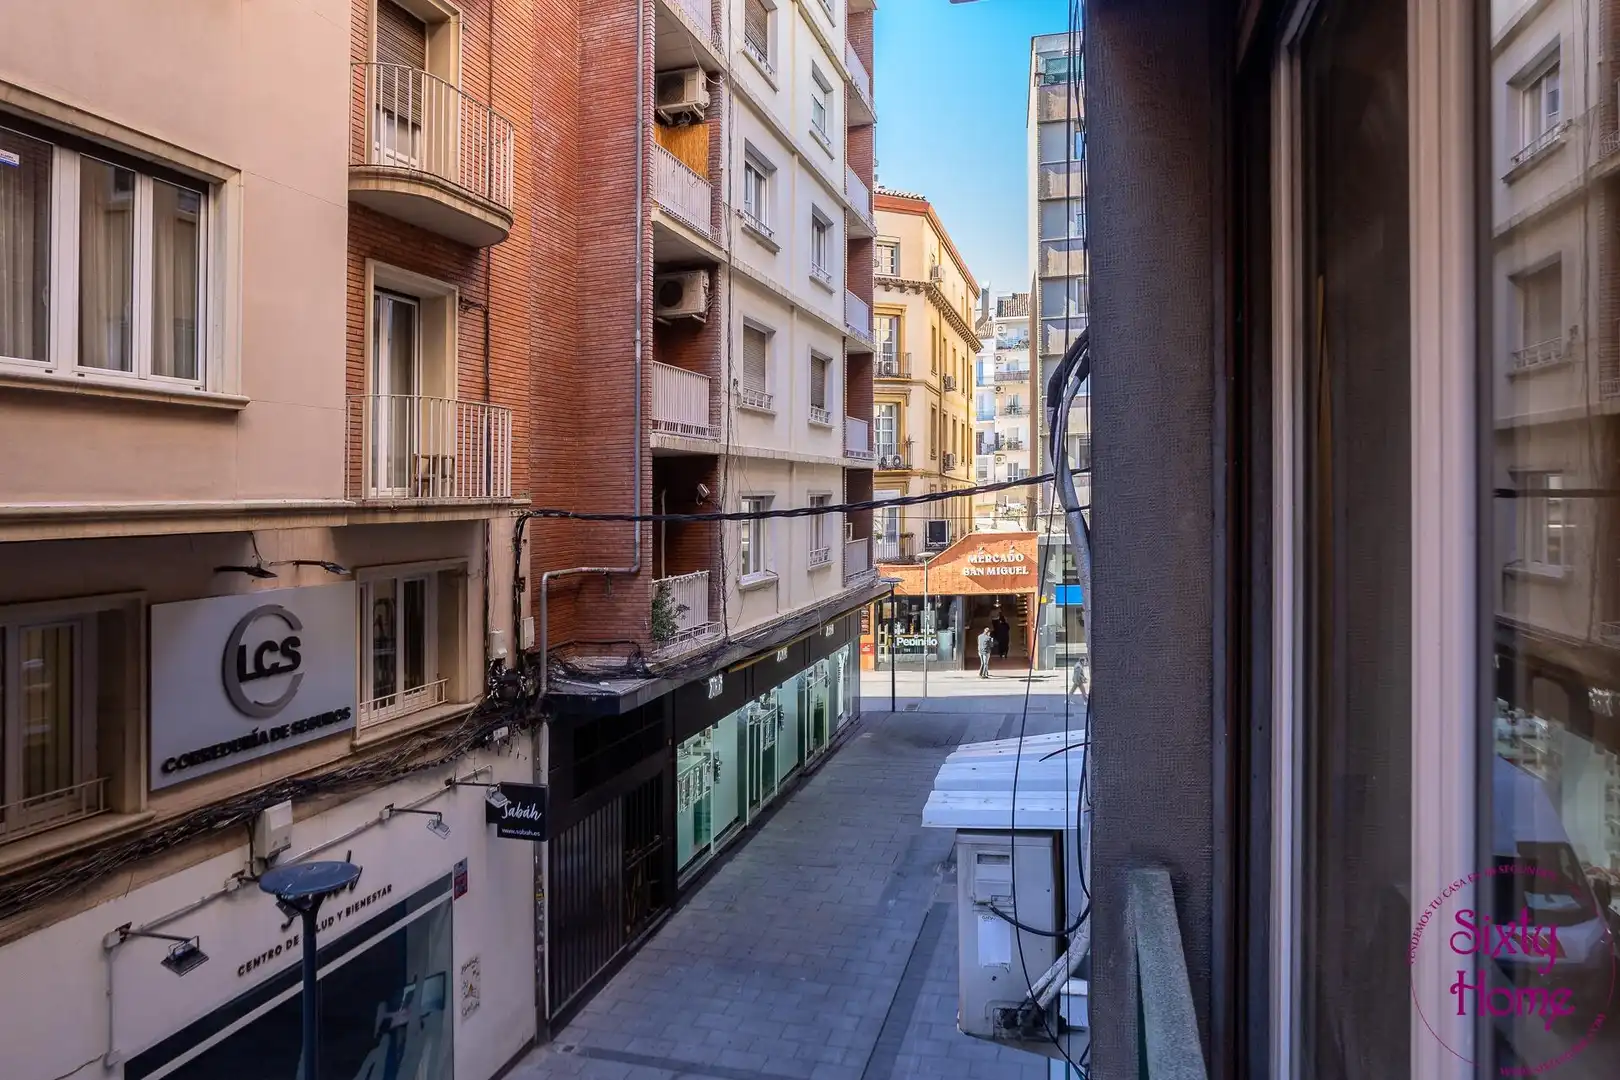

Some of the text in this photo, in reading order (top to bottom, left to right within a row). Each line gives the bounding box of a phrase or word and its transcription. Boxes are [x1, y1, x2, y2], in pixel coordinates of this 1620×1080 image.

[968, 553, 1025, 563] MERCADO
[963, 566, 1029, 576] SAN MIGUEL
[236, 636, 302, 682] LCS
[270, 724, 290, 742] DE
[501, 800, 542, 821] Sabáh
[237, 944, 283, 977] CENTRO
[285, 934, 300, 951] DE
[315, 915, 335, 933] LUD
[336, 910, 343, 922] Y
[345, 883, 393, 917] BIENESTAR
